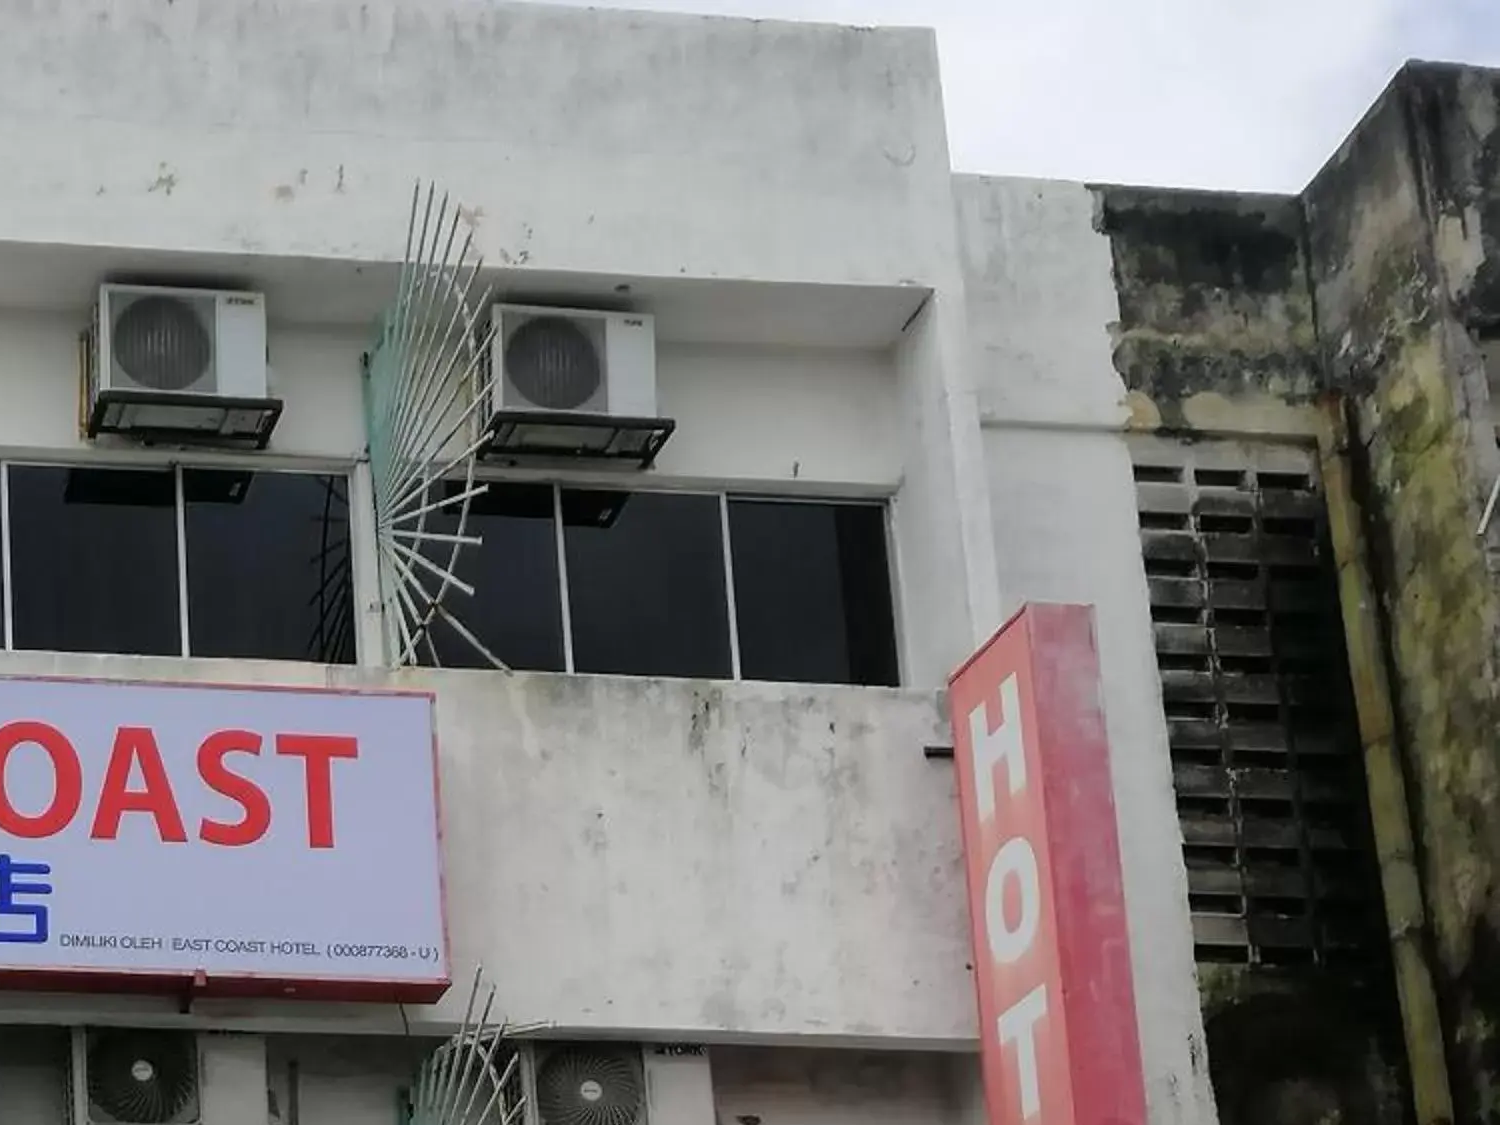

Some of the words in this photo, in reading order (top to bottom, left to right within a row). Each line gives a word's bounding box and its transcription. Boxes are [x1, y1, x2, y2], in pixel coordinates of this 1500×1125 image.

[59, 933, 118, 949] DIMILIKI
[119, 935, 163, 951] OLEH
[172, 937, 213, 952] EAST
[214, 939, 267, 954] COAST
[269, 941, 321, 956] HOTEL
